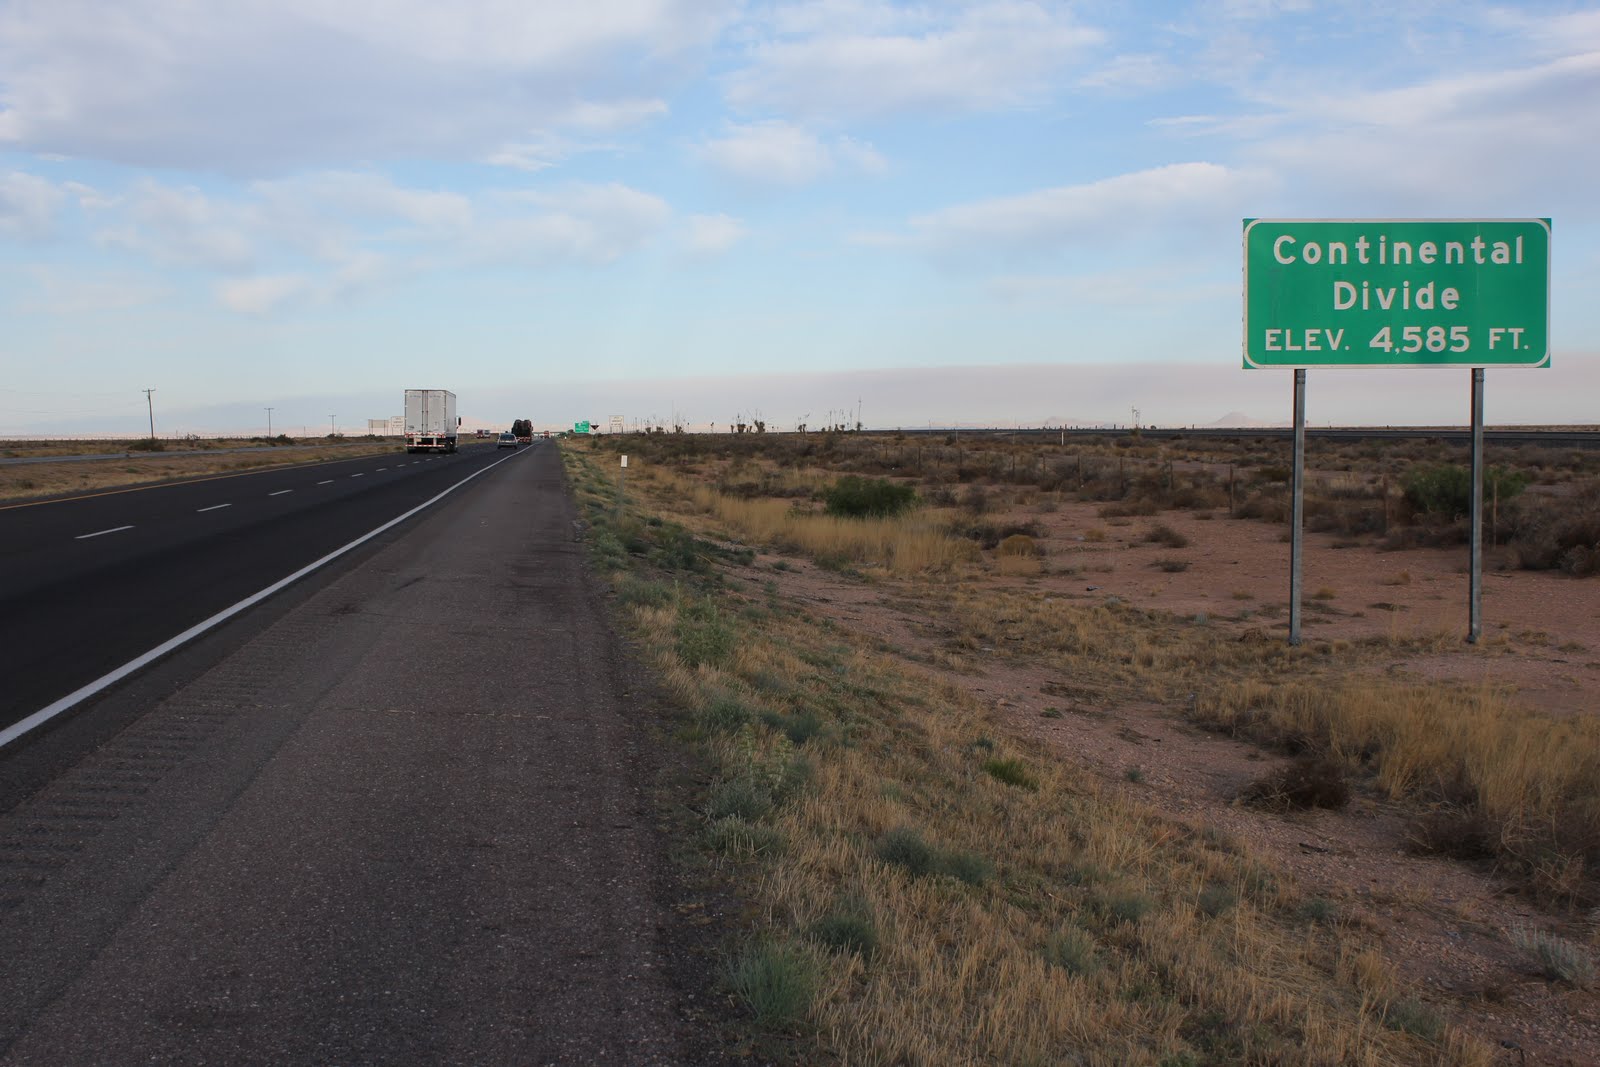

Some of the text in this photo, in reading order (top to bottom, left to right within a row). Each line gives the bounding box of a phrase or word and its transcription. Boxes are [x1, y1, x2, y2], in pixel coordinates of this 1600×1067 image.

[1273, 235, 1523, 265] Continental
[1333, 280, 1460, 310] Divide
[1265, 326, 1529, 355] ELEV. 4,585 FT.
